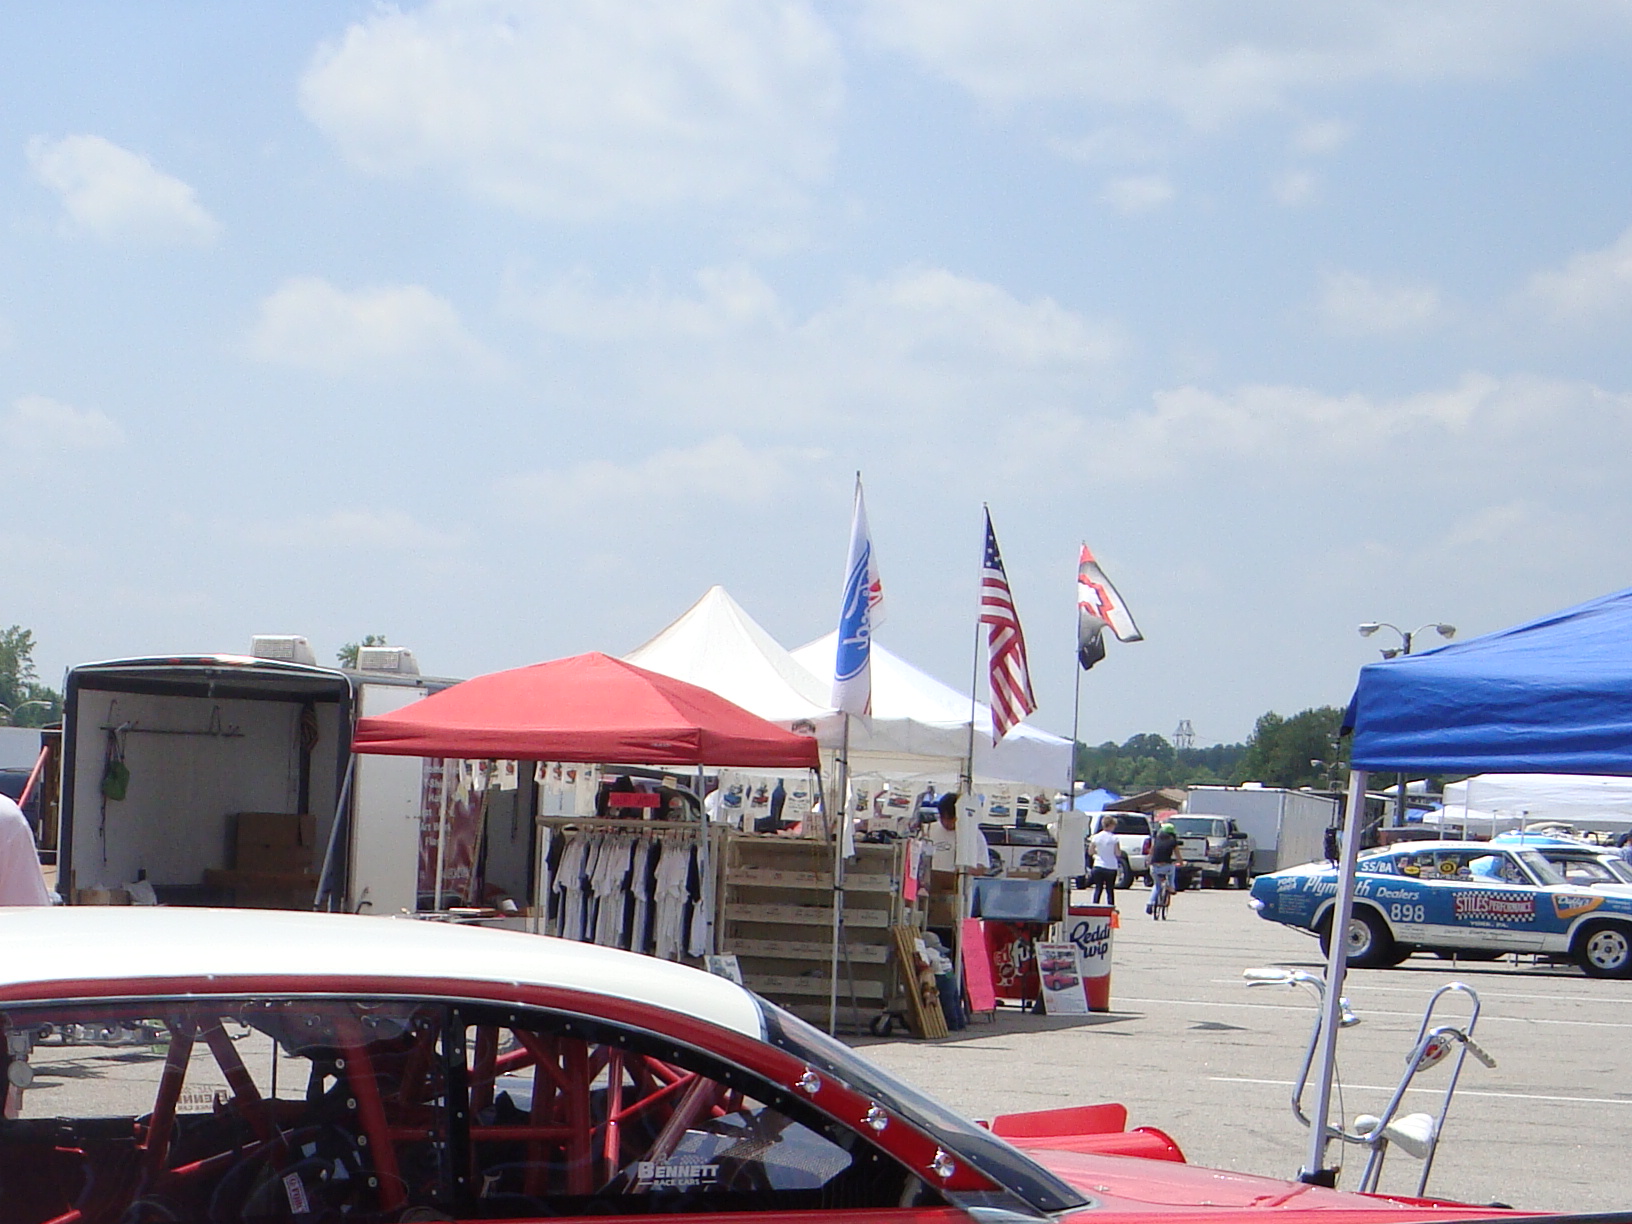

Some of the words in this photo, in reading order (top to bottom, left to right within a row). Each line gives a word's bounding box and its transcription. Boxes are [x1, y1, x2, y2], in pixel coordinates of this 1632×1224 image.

[1361, 861, 1392, 873] SS/BA
[1303, 876, 1373, 897] Plymth
[1376, 887, 1419, 900] Dealers
[1391, 903, 1425, 922] 898
[1456, 896, 1489, 913] STILES
[1070, 921, 1110, 950] Reddi
[1083, 942, 1109, 960] wip
[637, 1161, 720, 1179] BENNETT
[654, 1179, 676, 1187] RACE
